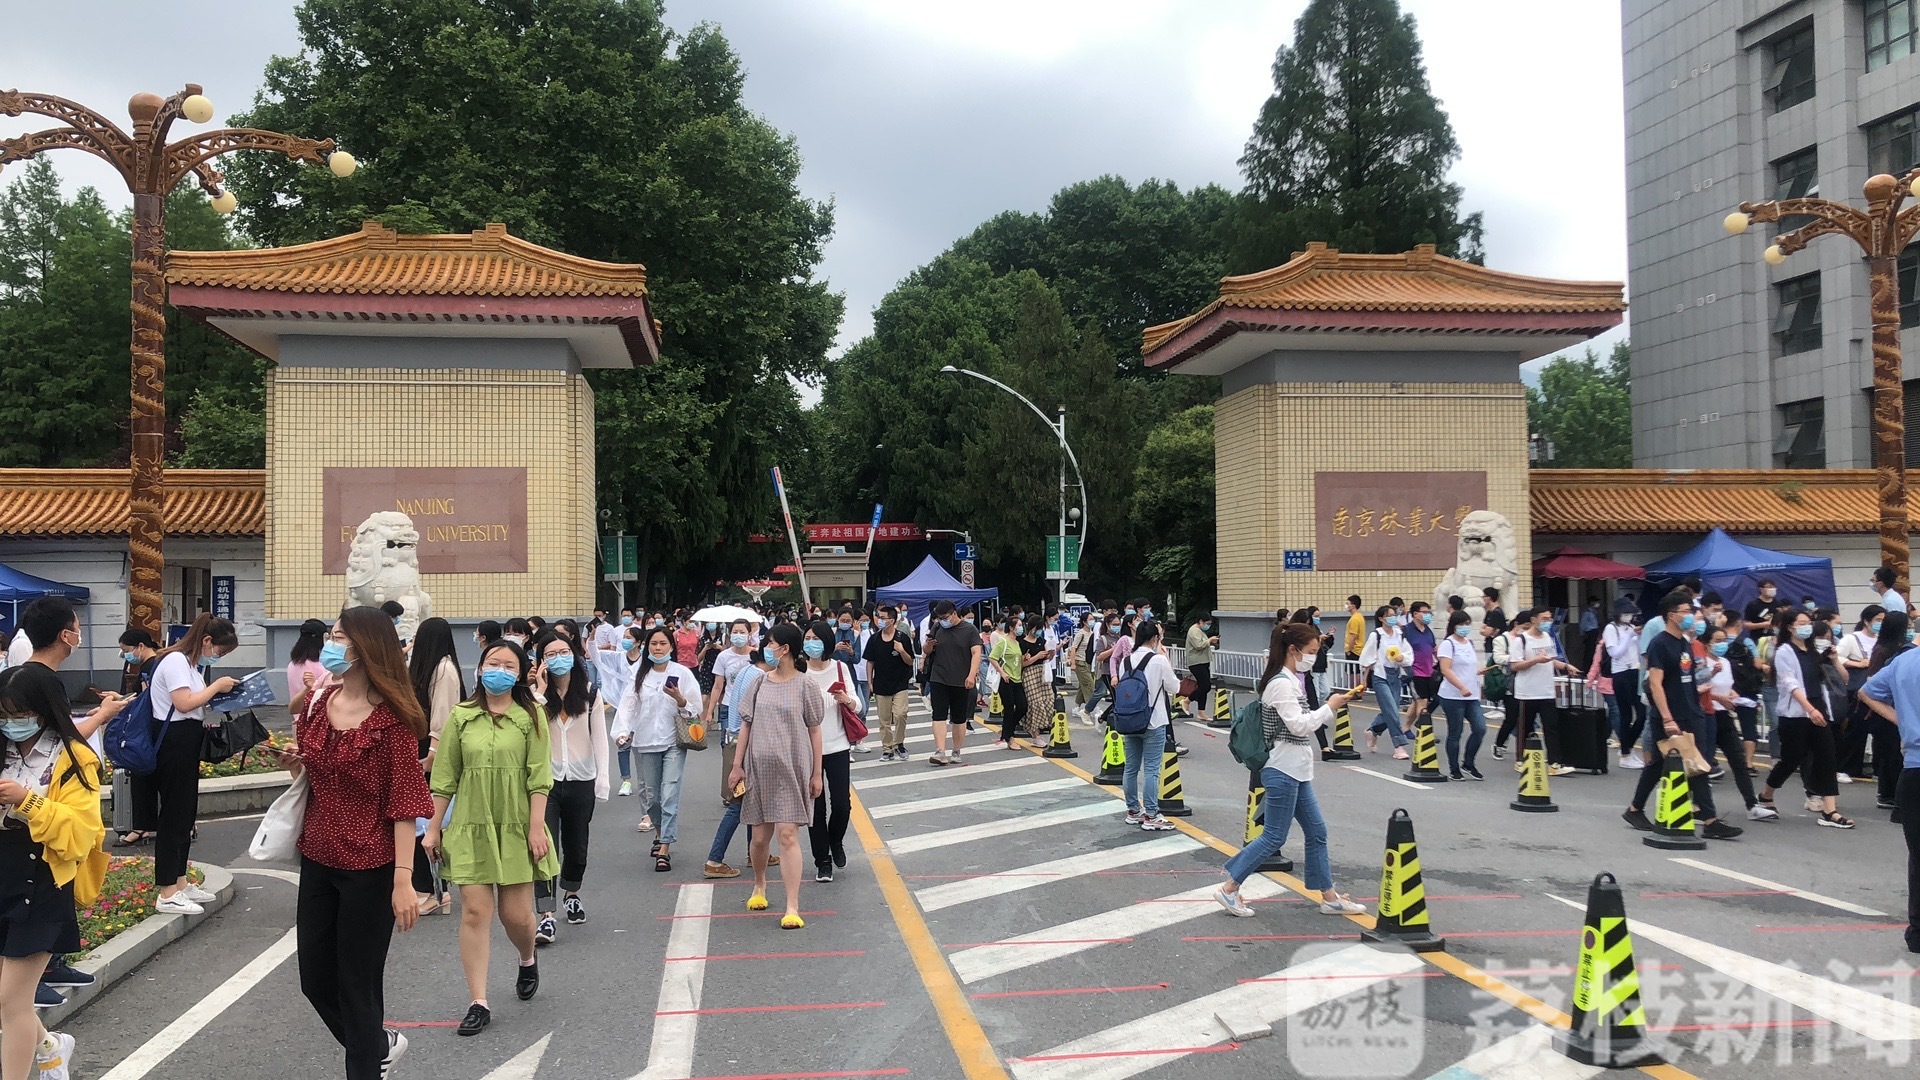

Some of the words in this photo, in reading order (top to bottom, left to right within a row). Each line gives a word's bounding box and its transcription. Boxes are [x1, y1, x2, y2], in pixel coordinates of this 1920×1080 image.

[396, 498, 455, 516] NANJING
[426, 524, 510, 543] UNIVERSITY
[1286, 557, 1302, 565] 159
[1058, 721, 1066, 743] 禁止停车
[1112, 741, 1120, 764] 禁止停车
[1533, 761, 1544, 792] 禁止停车
[1383, 869, 1394, 913] 禁止停车
[1579, 952, 1593, 1007] 禁止停车
